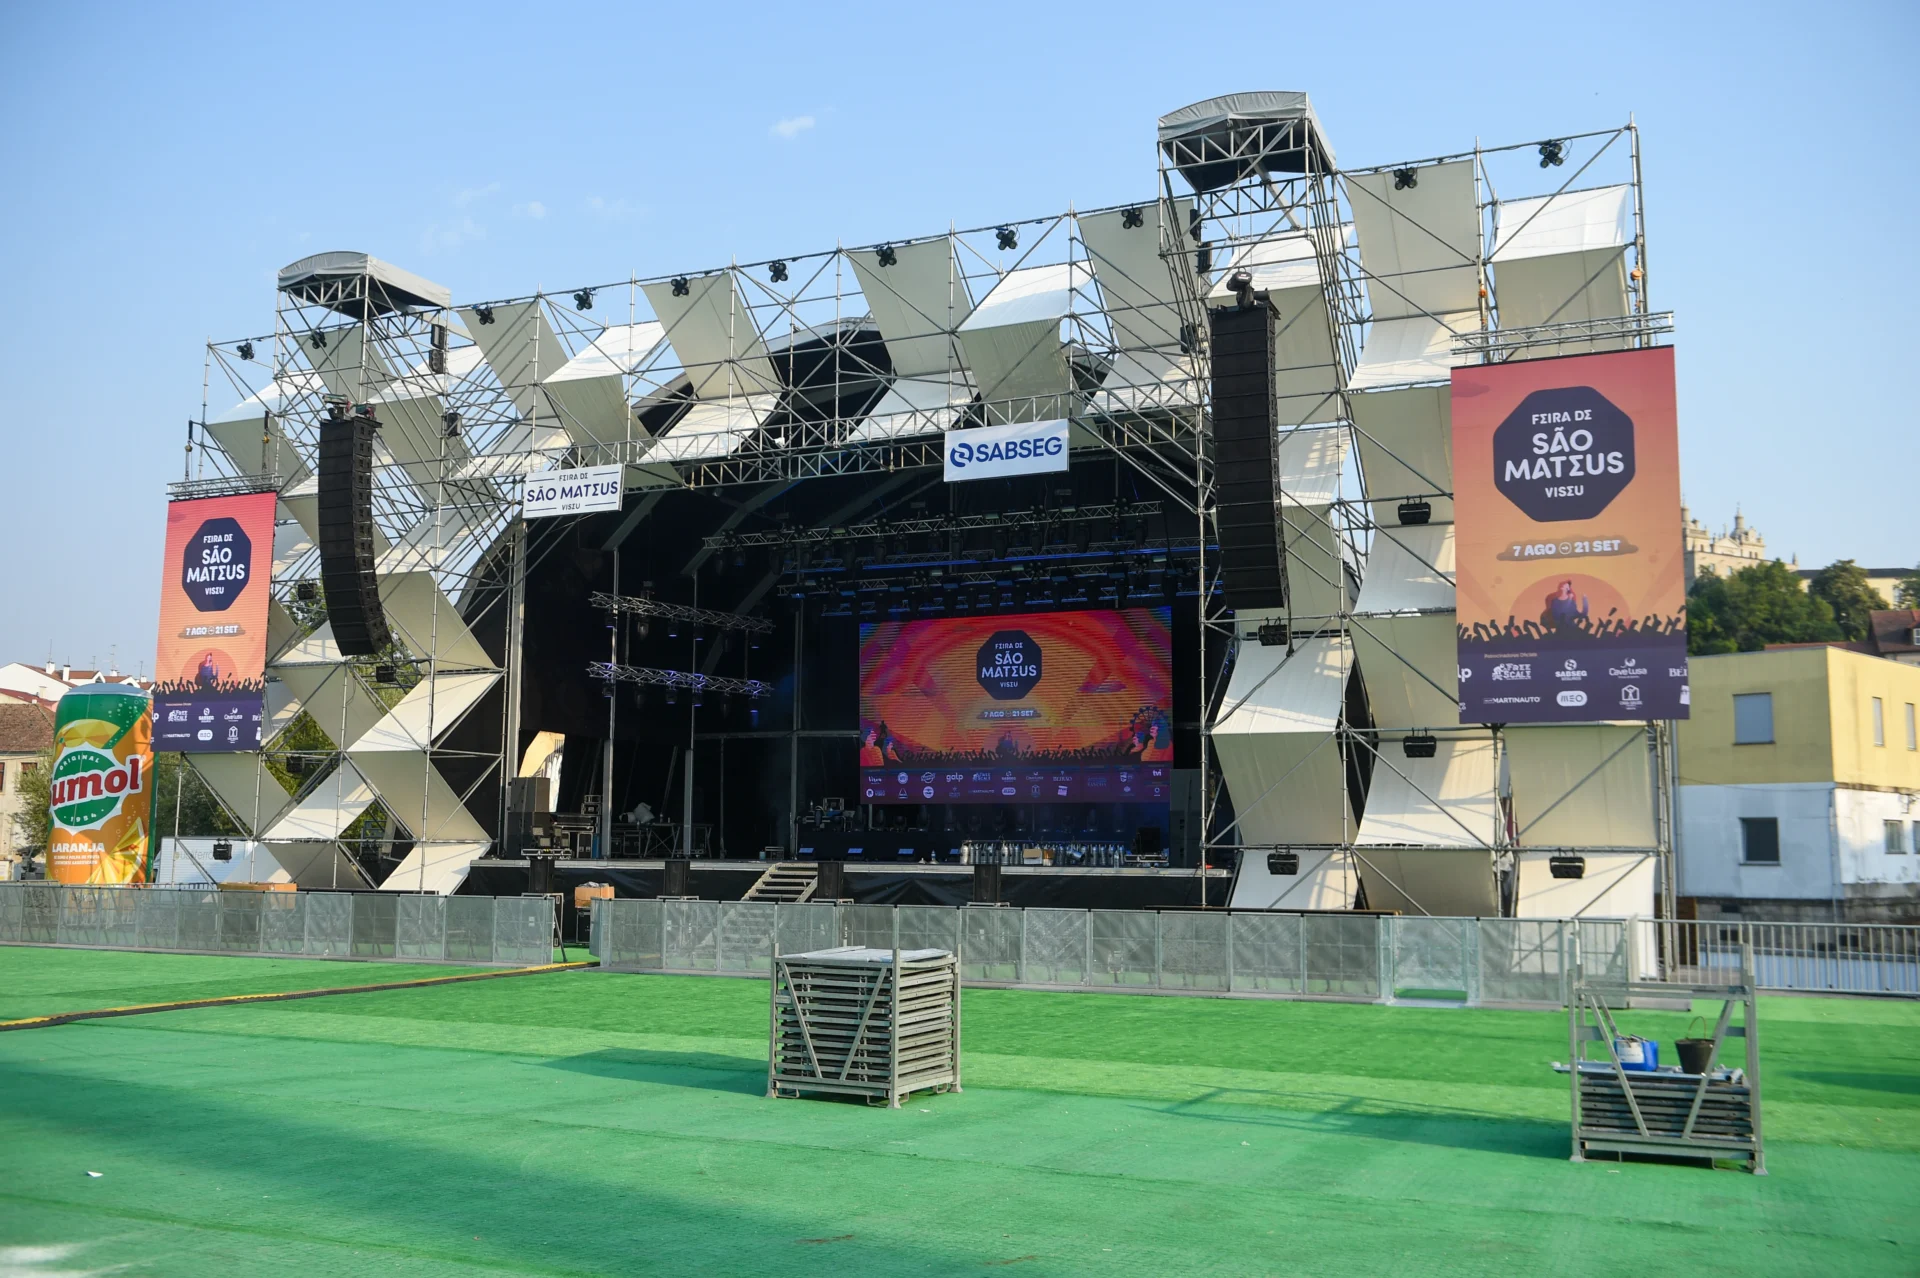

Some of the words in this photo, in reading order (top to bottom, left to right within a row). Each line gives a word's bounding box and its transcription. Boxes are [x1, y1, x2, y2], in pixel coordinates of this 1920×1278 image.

[1532, 411, 1571, 425] FEIRA
[1574, 409, 1592, 421] DE
[1532, 426, 1593, 455] SÃO
[975, 436, 1063, 462] SABSEG
[1504, 451, 1625, 482] MATEUS
[526, 486, 557, 502] SÃO
[560, 481, 618, 500] MATEUS
[1544, 485, 1584, 498] VISEU
[561, 503, 581, 511] VISEU
[203, 535, 223, 544] FEIRA
[224, 533, 233, 542] DE
[202, 545, 232, 565] SÃO
[1513, 545, 1522, 557] 7
[1524, 543, 1556, 556] AGO
[1574, 541, 1589, 553] 21
[1592, 540, 1621, 552] SET
[186, 563, 245, 583] MATEUS
[205, 586, 224, 595] VISEU
[186, 628, 191, 636] 7
[191, 626, 207, 636] AGO
[215, 626, 223, 634] 21
[224, 625, 239, 634] SET
[995, 650, 1023, 665] SÃO
[981, 664, 1037, 679] MATEUS
[1555, 670, 1587, 678] SABSEG
[59, 754, 100, 771] ORIGINAL
[50, 757, 140, 807] umol
[946, 772, 963, 782] galp
[52, 842, 105, 853] LARANJA
